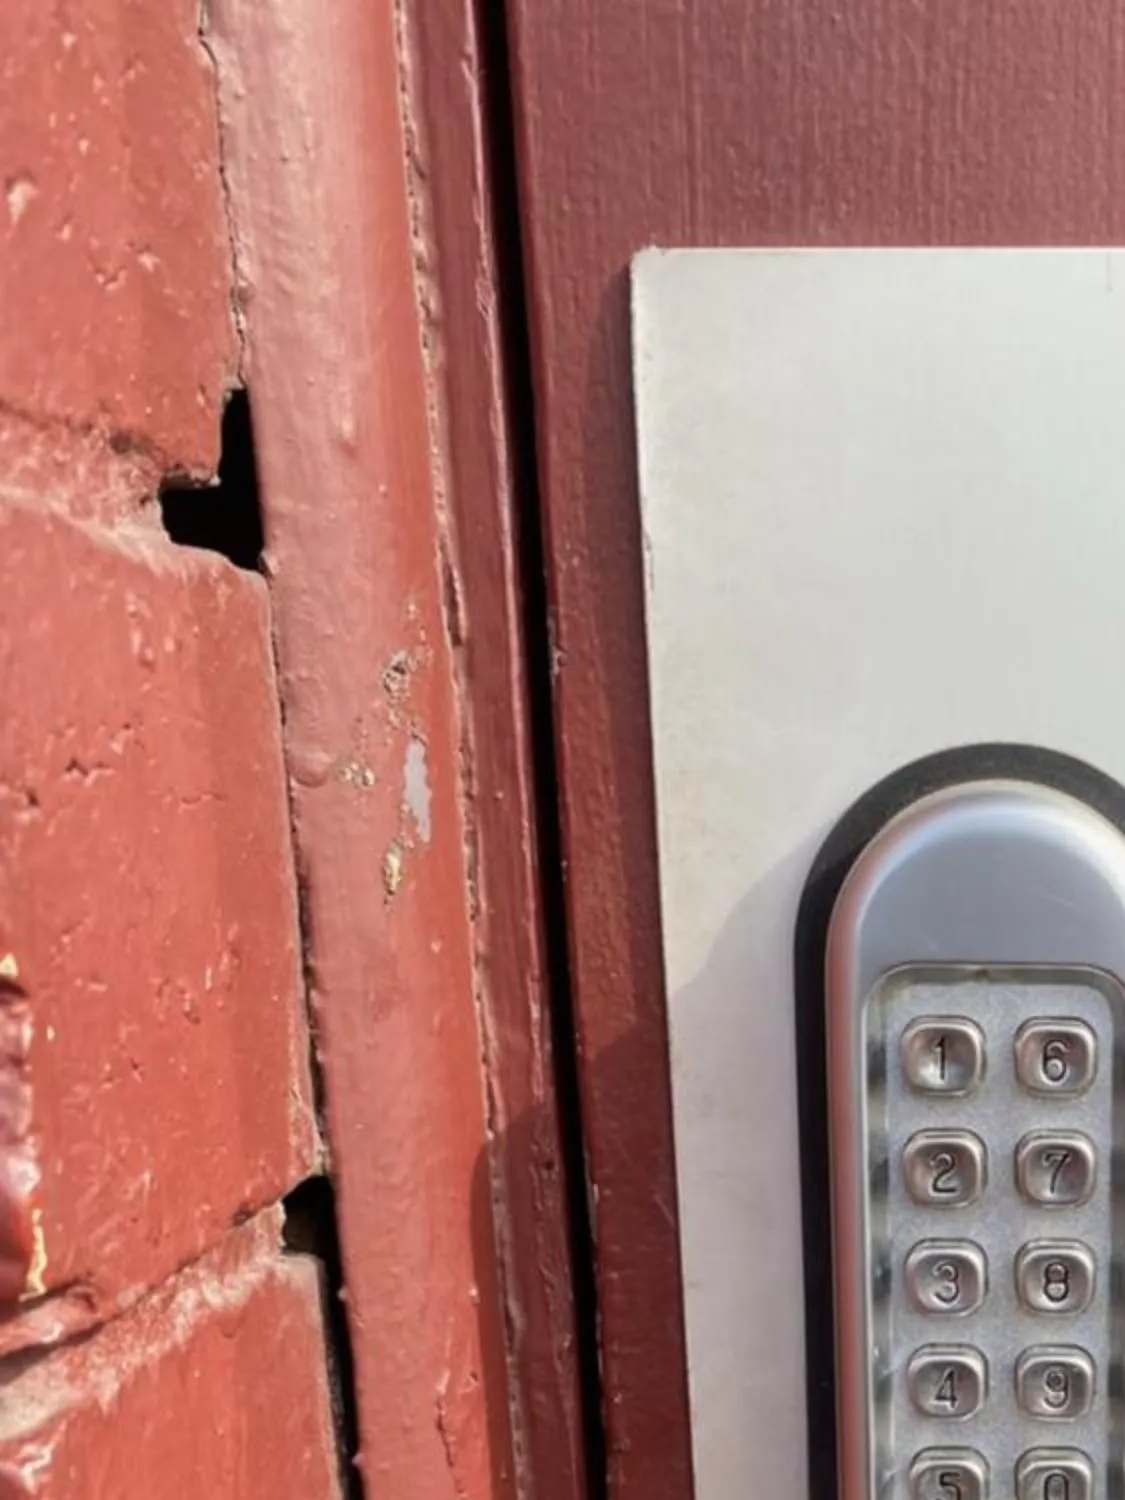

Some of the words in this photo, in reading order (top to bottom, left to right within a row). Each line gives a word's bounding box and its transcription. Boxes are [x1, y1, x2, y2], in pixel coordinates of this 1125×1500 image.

[931, 1036, 946, 1081] 1
[1041, 1038, 1068, 1083] 6
[931, 1153, 957, 1193] 2
[1044, 1152, 1070, 1194] 7
[932, 1261, 960, 1303] 3
[1043, 1262, 1070, 1304] 8
[934, 1367, 958, 1410] 4
[1043, 1367, 1069, 1409] 9
